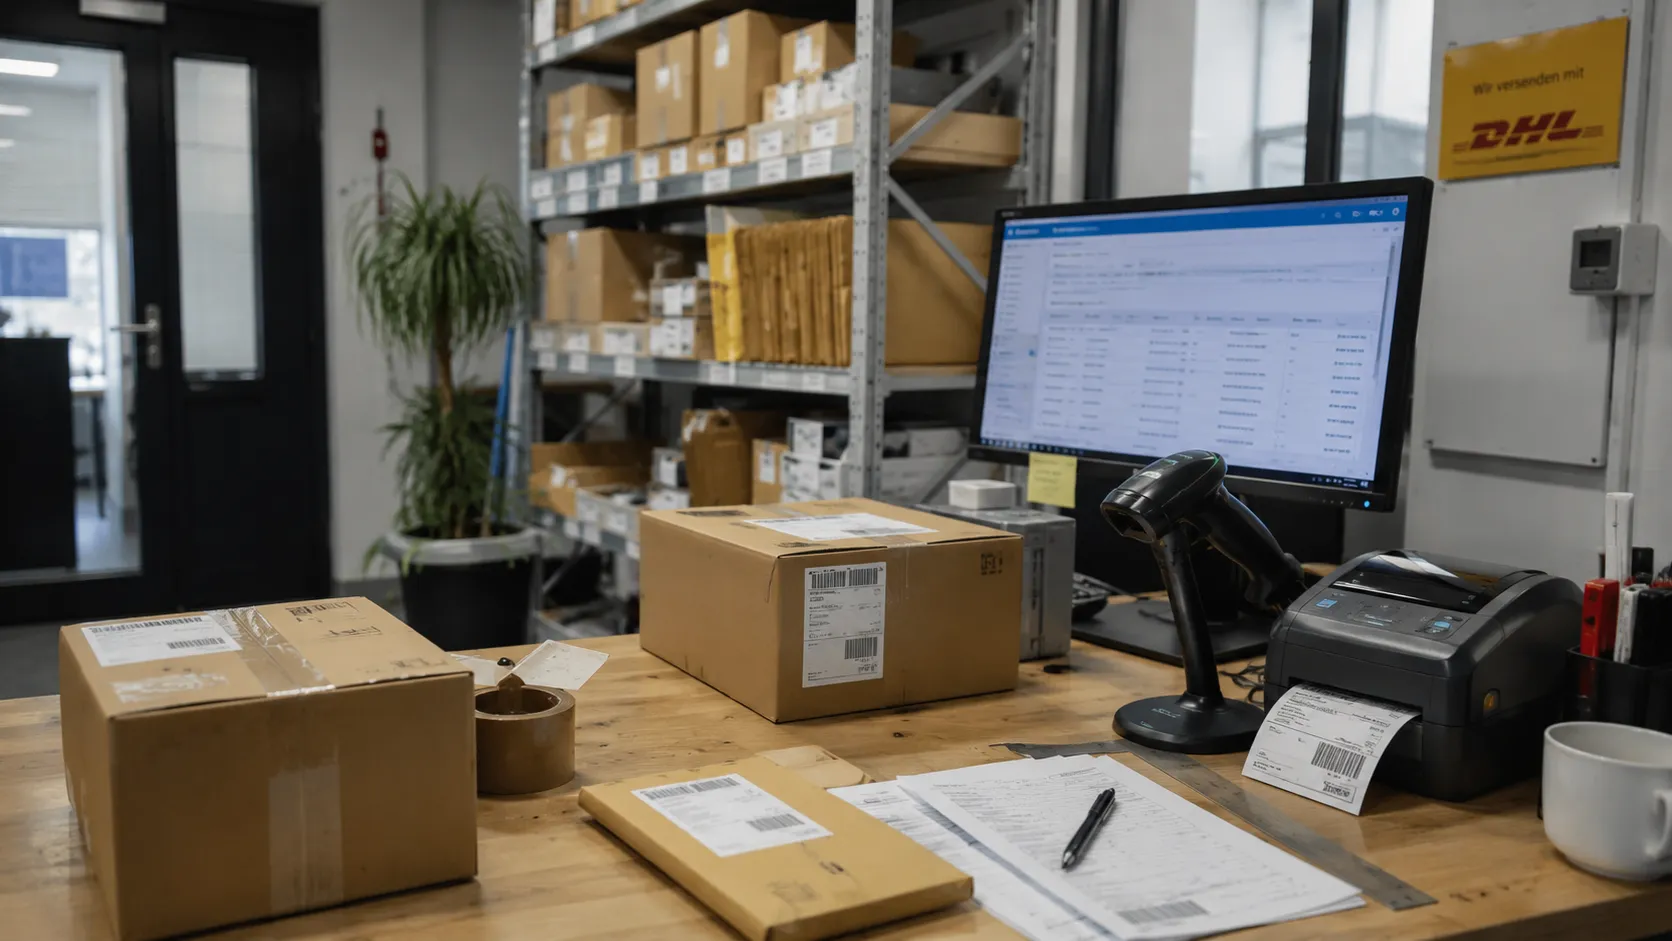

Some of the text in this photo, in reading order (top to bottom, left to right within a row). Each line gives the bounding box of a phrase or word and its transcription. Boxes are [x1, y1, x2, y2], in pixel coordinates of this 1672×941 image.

[1473, 66, 1584, 96] Wir versenden mit
[1470, 110, 1582, 150] DHL
